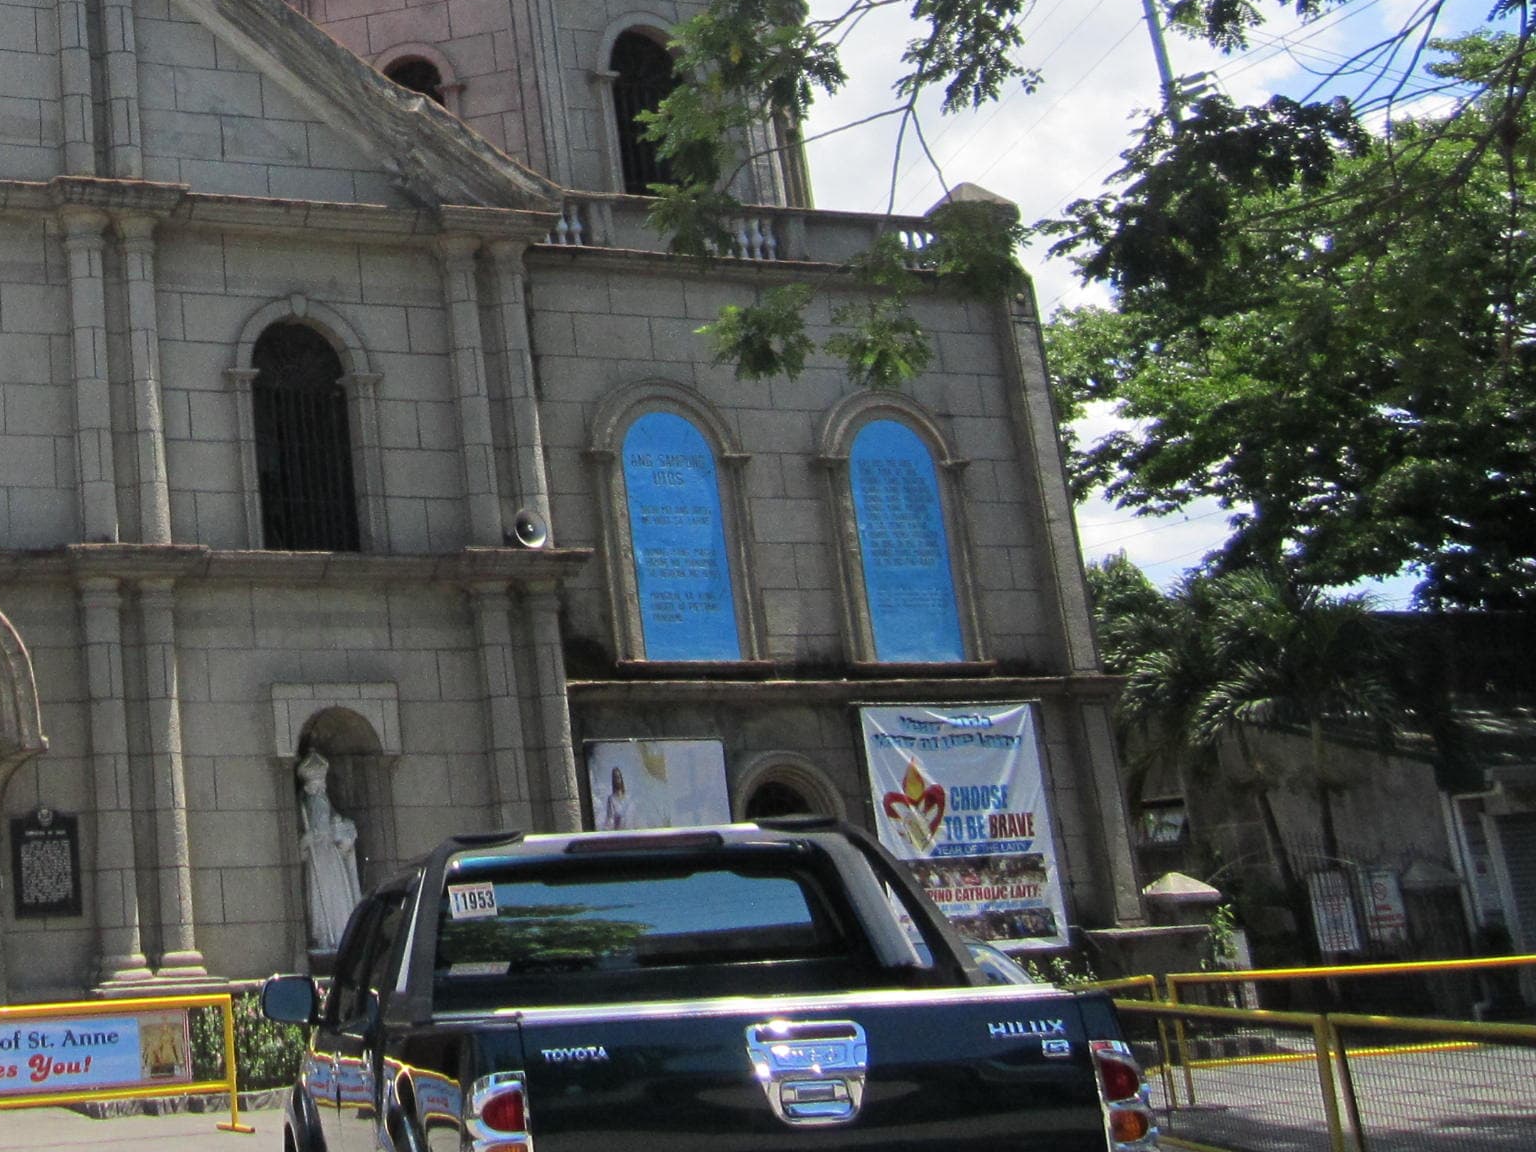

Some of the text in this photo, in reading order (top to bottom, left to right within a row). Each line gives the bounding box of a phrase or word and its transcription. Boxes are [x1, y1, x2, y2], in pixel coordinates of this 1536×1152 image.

[950, 784, 1008, 811] CHOOSE
[944, 812, 1035, 841] TO BE BRAVE
[938, 845, 962, 856] YEAR
[964, 844, 977, 854] OF
[462, 890, 495, 910] 1953
[955, 885, 1008, 901] CATHOLIC
[987, 1019, 1065, 1039] HILUX
[0, 1030, 22, 1051] of
[27, 1030, 55, 1049] St.
[61, 1029, 120, 1048] Anne
[541, 1046, 610, 1064] TOYOTA
[27, 1053, 93, 1083] You!
